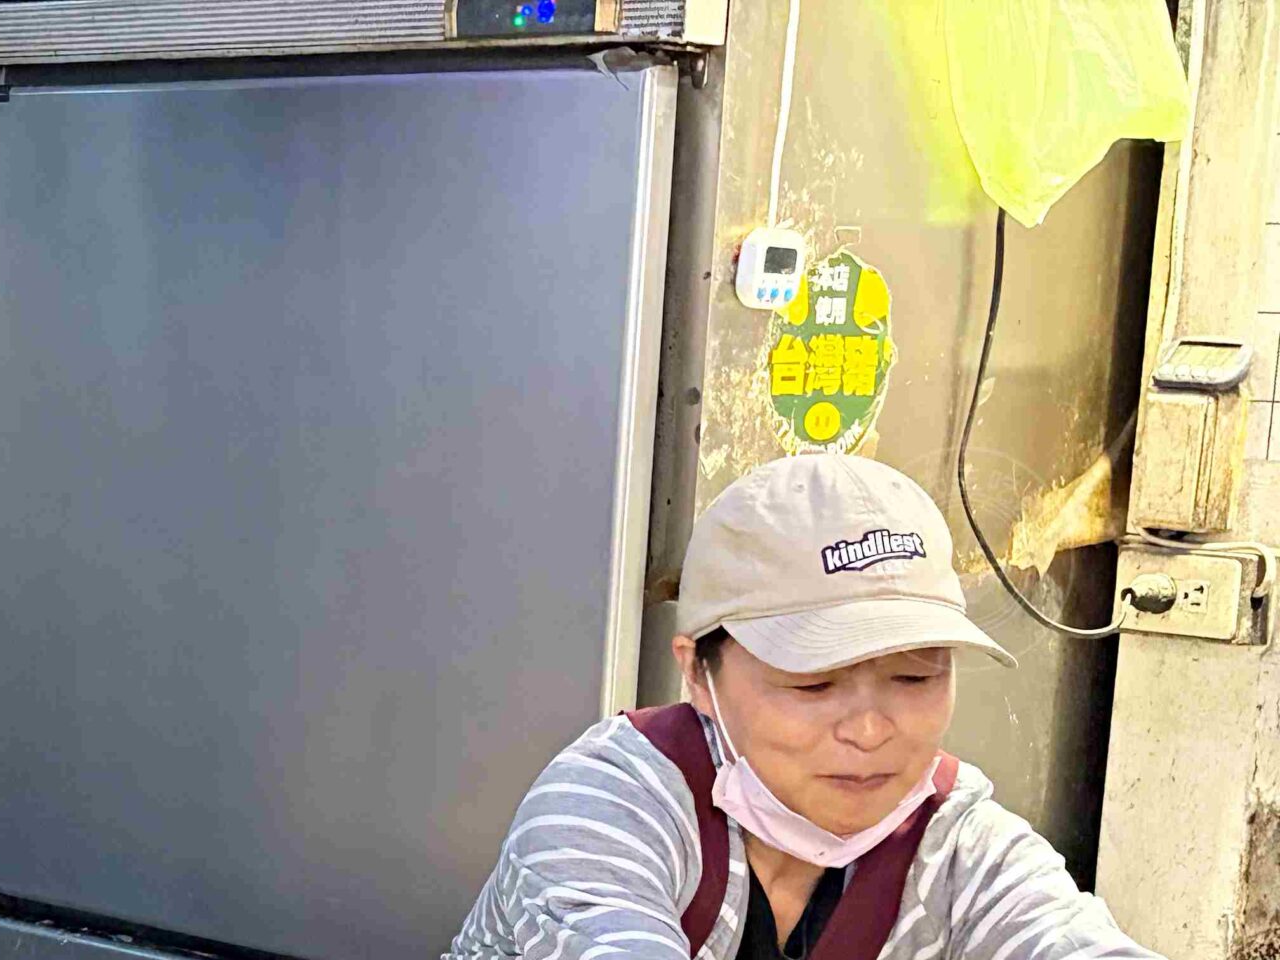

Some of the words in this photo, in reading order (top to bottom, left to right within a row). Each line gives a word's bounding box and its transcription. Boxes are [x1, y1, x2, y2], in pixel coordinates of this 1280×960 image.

[771, 333, 879, 396] 台灣豬
[823, 530, 925, 572] kindliest
